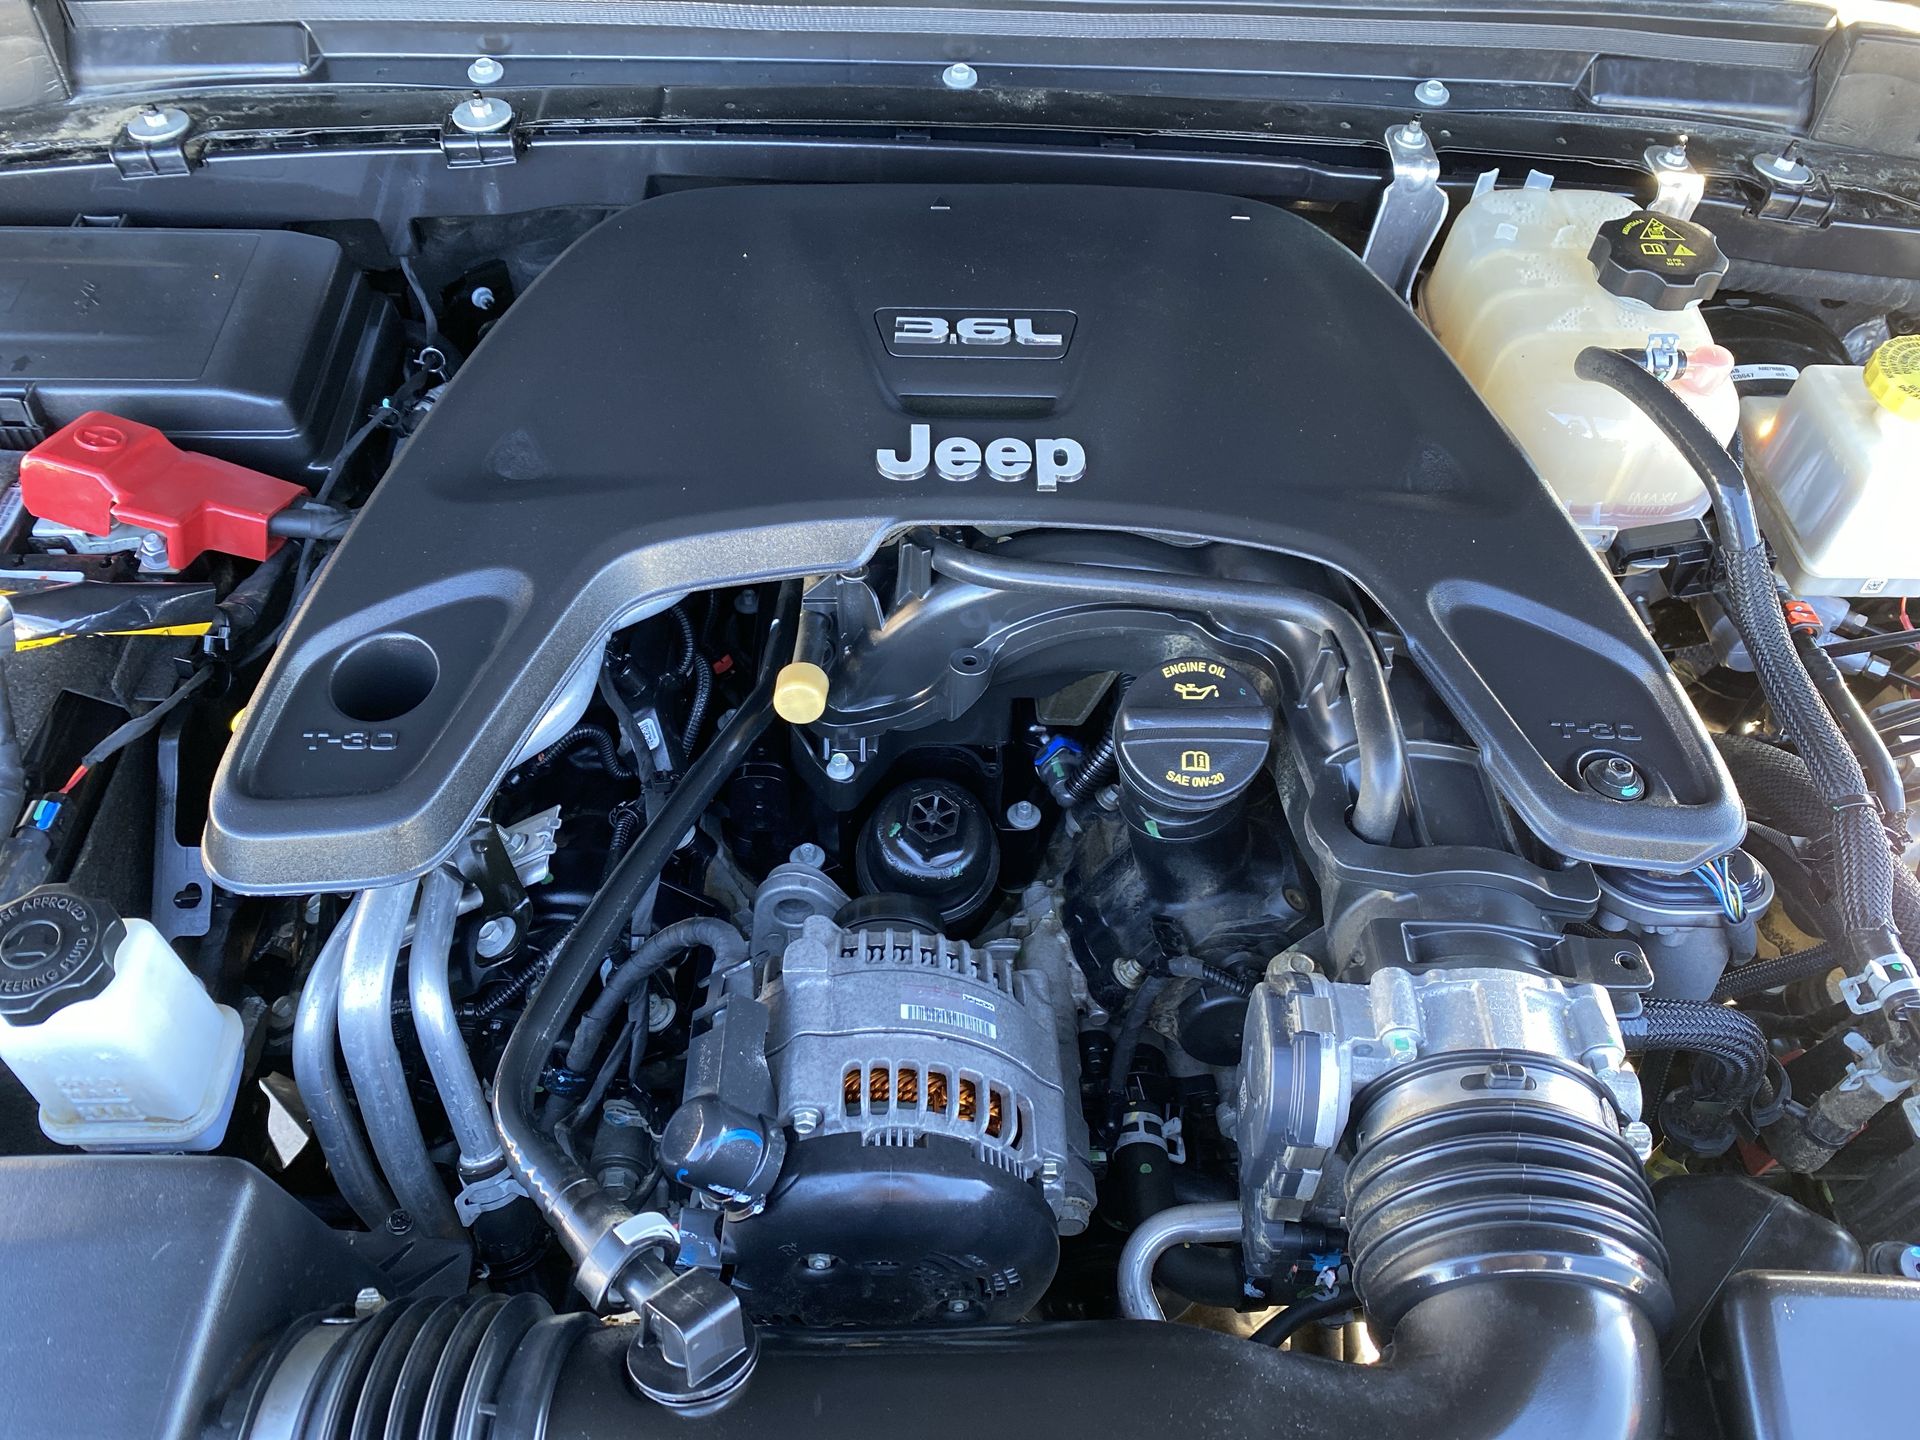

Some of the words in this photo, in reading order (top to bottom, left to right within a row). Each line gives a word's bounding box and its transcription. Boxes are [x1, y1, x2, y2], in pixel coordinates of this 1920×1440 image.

[894, 316, 1063, 345] 3.6L
[876, 424, 1087, 492] Jeep
[1161, 661, 1207, 679] ENGINE
[1208, 664, 1227, 679] OIL
[302, 731, 399, 751] T-30
[1165, 770, 1191, 787] SAE
[1191, 772, 1226, 788] 0W-20
[21, 896, 88, 922] APPROVED
[60, 937, 88, 972] FLUID
